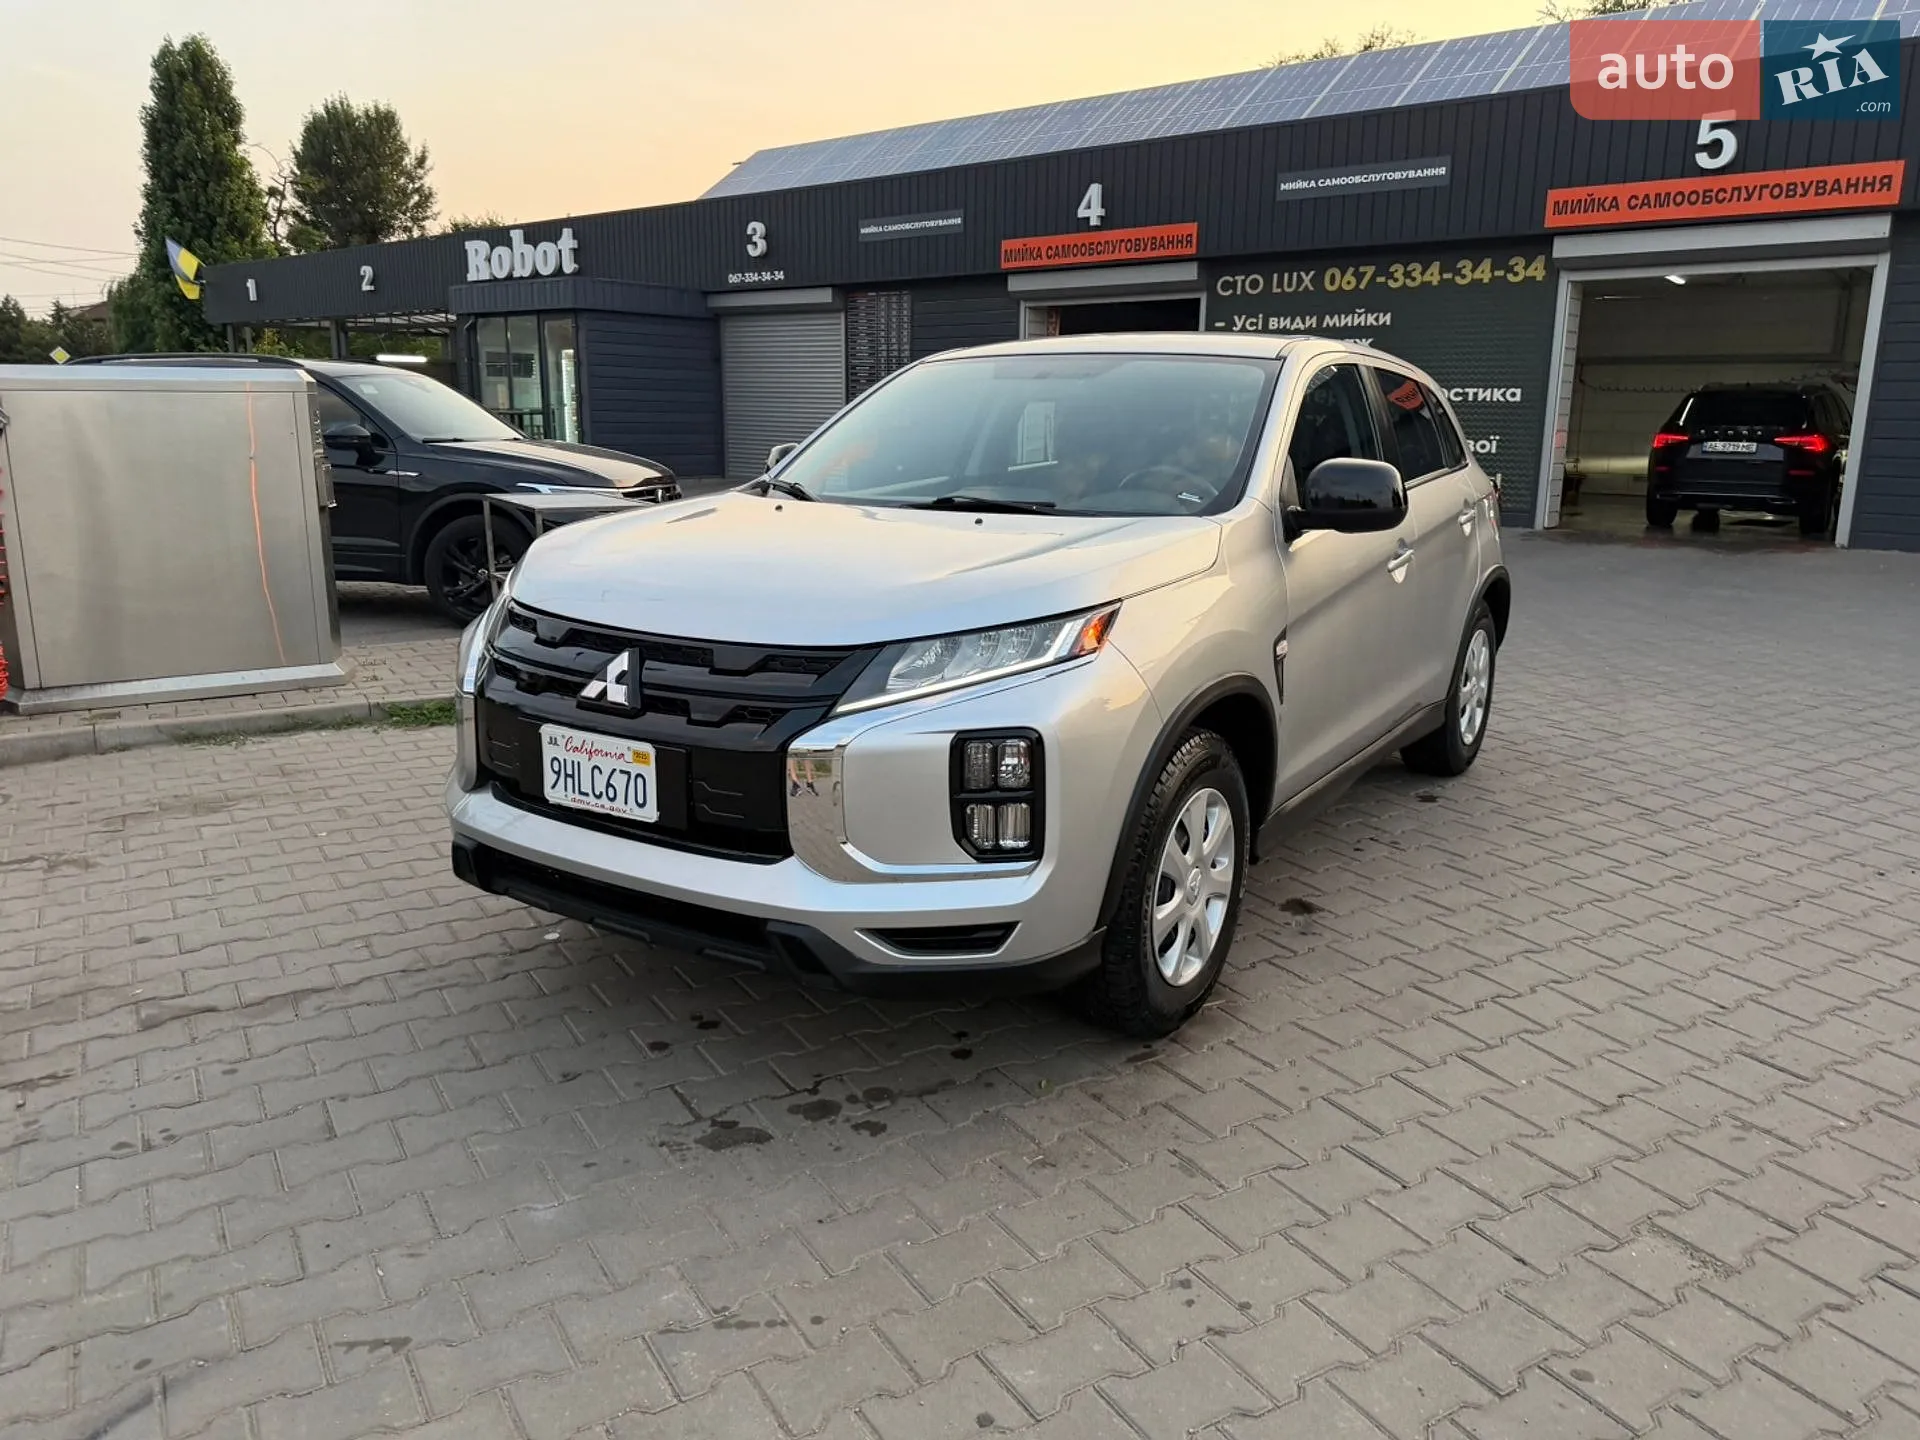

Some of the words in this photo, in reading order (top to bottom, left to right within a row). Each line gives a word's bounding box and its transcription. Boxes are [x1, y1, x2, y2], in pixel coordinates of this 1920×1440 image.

[1695, 109, 1738, 169] 5
[1280, 178, 1316, 191] МИЙКА
[1318, 166, 1447, 187] САМООБСЛУГОВУВАННЯ
[1552, 192, 1620, 216] МИЙКА
[1627, 174, 1894, 210] САМООБСЛУГОВУВАННЯ
[1077, 183, 1105, 226] 4
[465, 227, 579, 281] Robot
[746, 221, 767, 257] 3
[1003, 243, 1042, 263] МИЙКА
[1046, 233, 1193, 260] САМООБСЛУГОВУВАННЯ
[246, 278, 257, 301] 1
[360, 265, 374, 291] 2
[728, 270, 784, 283] 067-334-34-34
[1216, 275, 1264, 296] СТО
[1272, 270, 1316, 293] LUX
[1324, 255, 1547, 292] 067-334-34-34
[1232, 313, 1262, 331] Усі
[1268, 315, 1317, 331] види
[1322, 308, 1391, 328] мийки
[564, 736, 632, 762] California
[550, 756, 647, 808] 9HLC670
